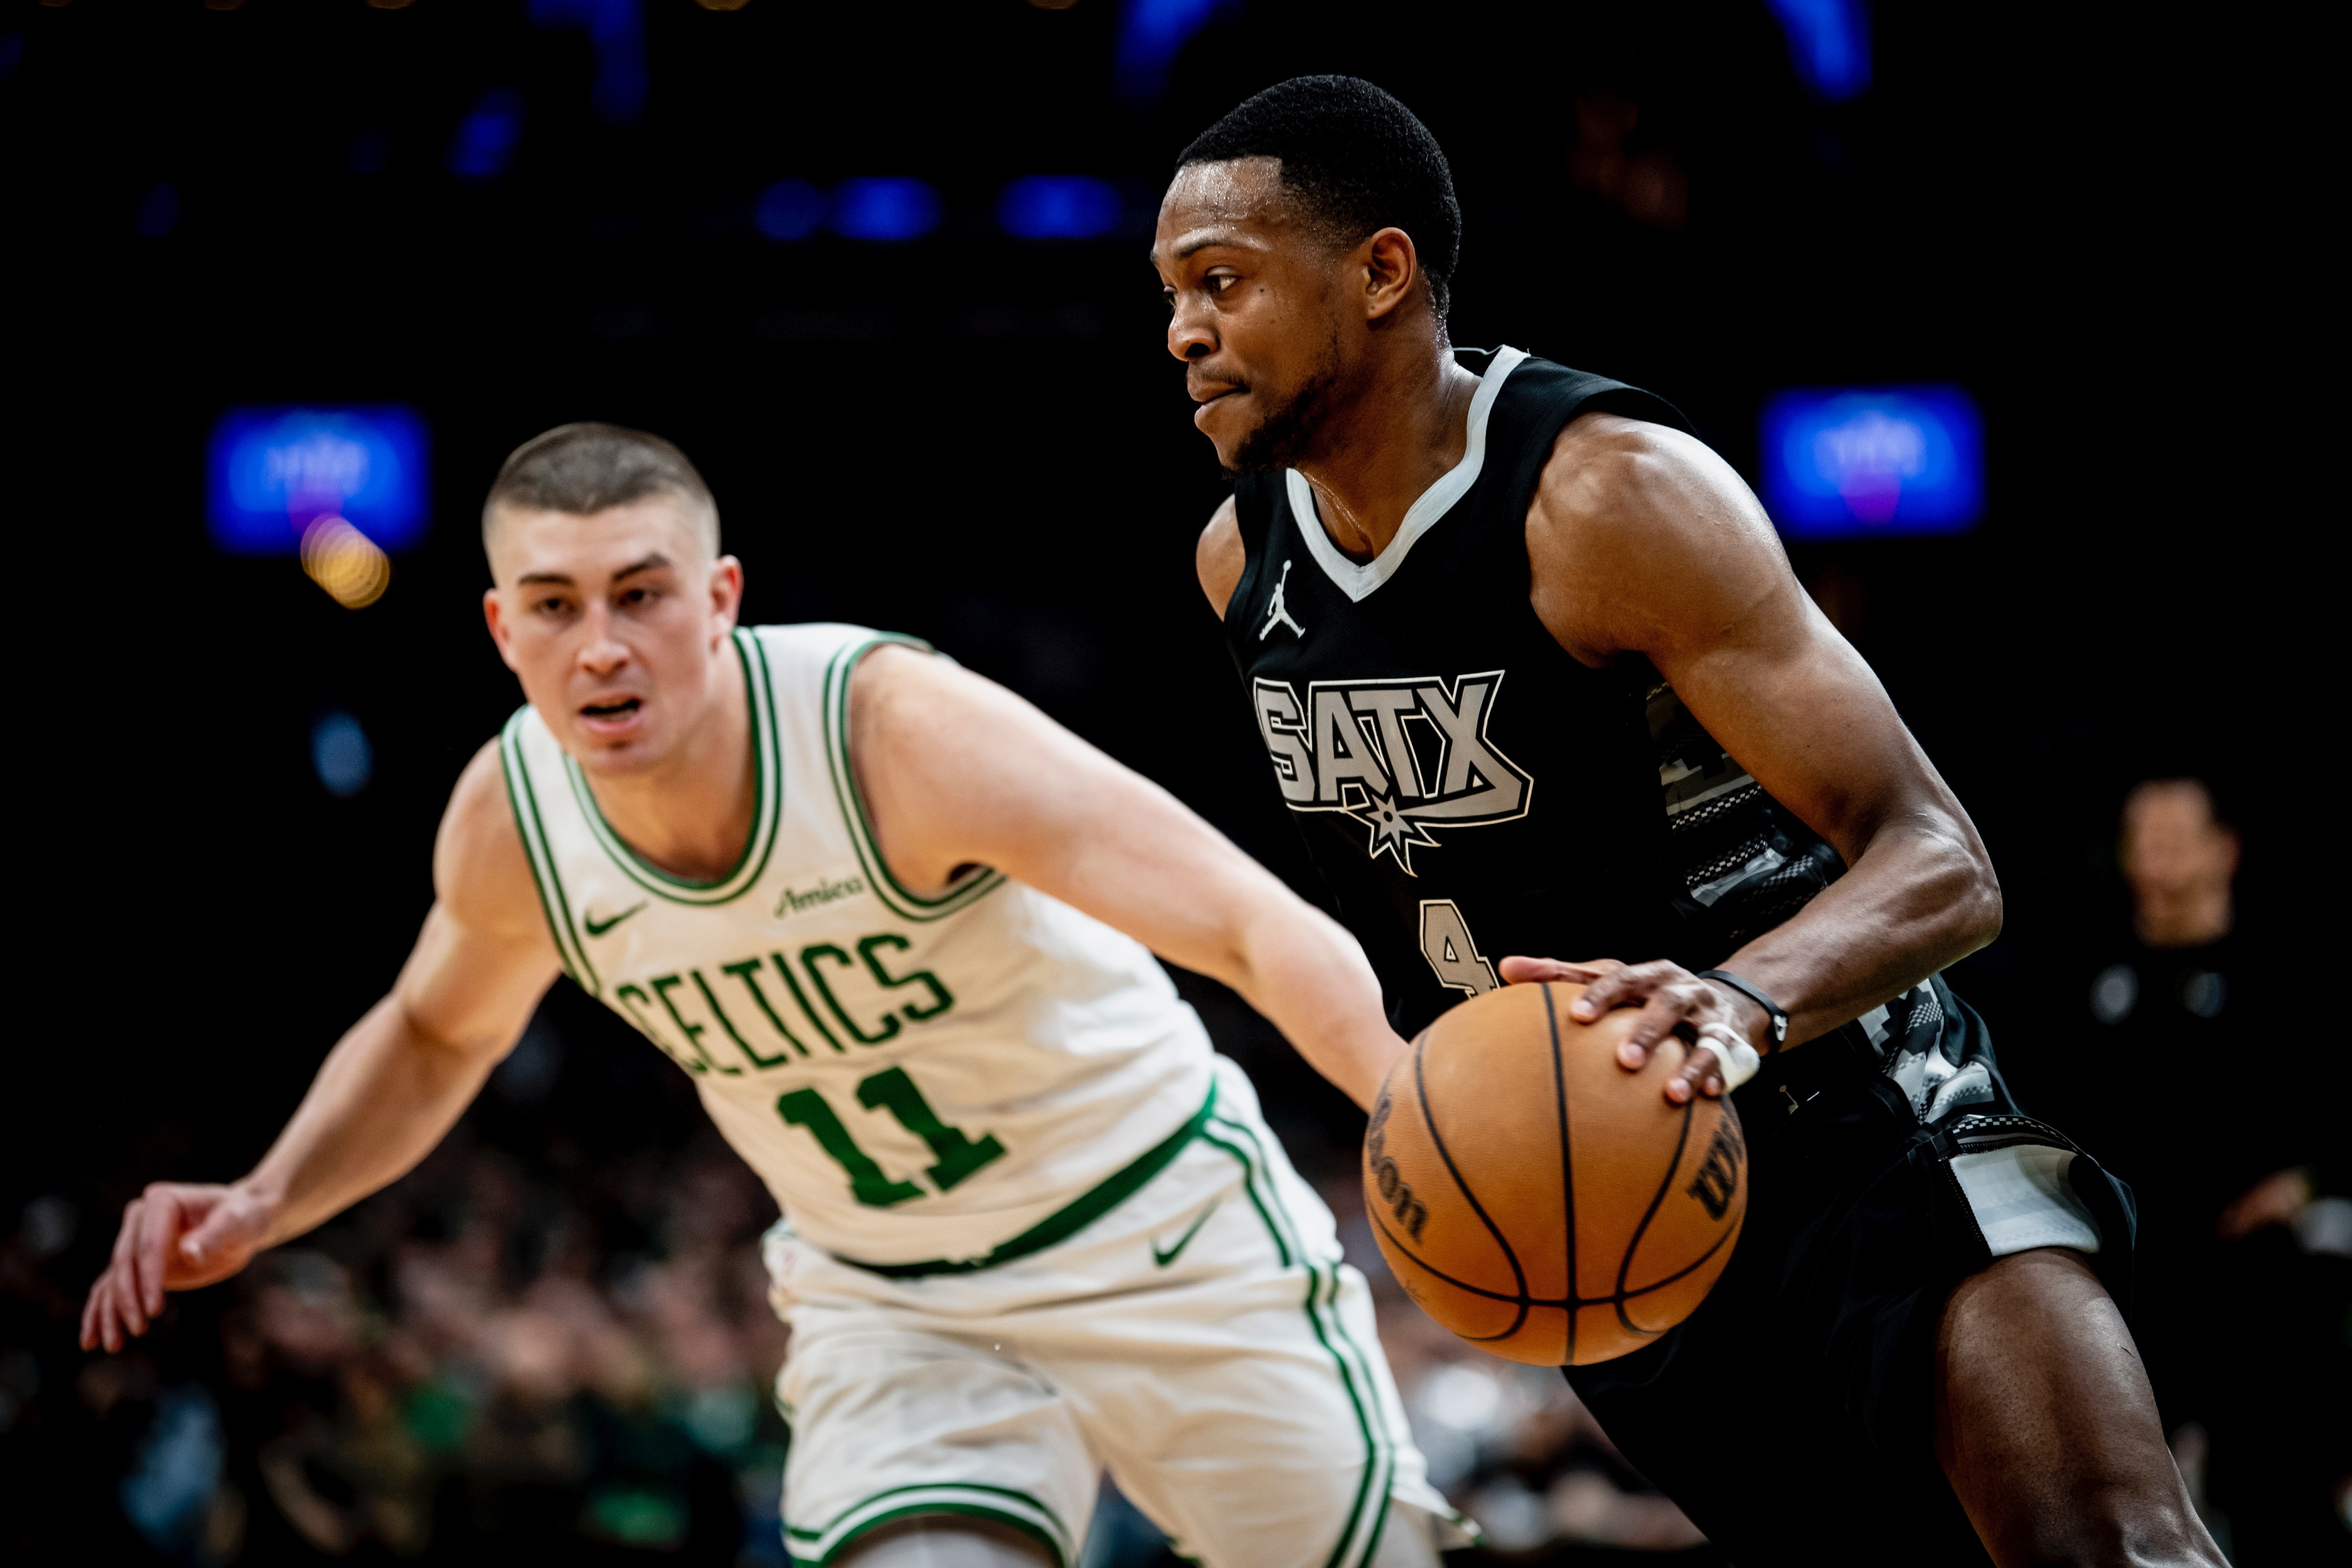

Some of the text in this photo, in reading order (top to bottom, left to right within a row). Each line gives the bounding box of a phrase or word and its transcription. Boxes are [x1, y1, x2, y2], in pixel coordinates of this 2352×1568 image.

[1254, 669, 1534, 830] SATX
[774, 876, 864, 919] Amica
[1420, 899, 1501, 1001] 4
[616, 934, 954, 1076] CELTICS
[777, 1066, 1008, 1208] 11
